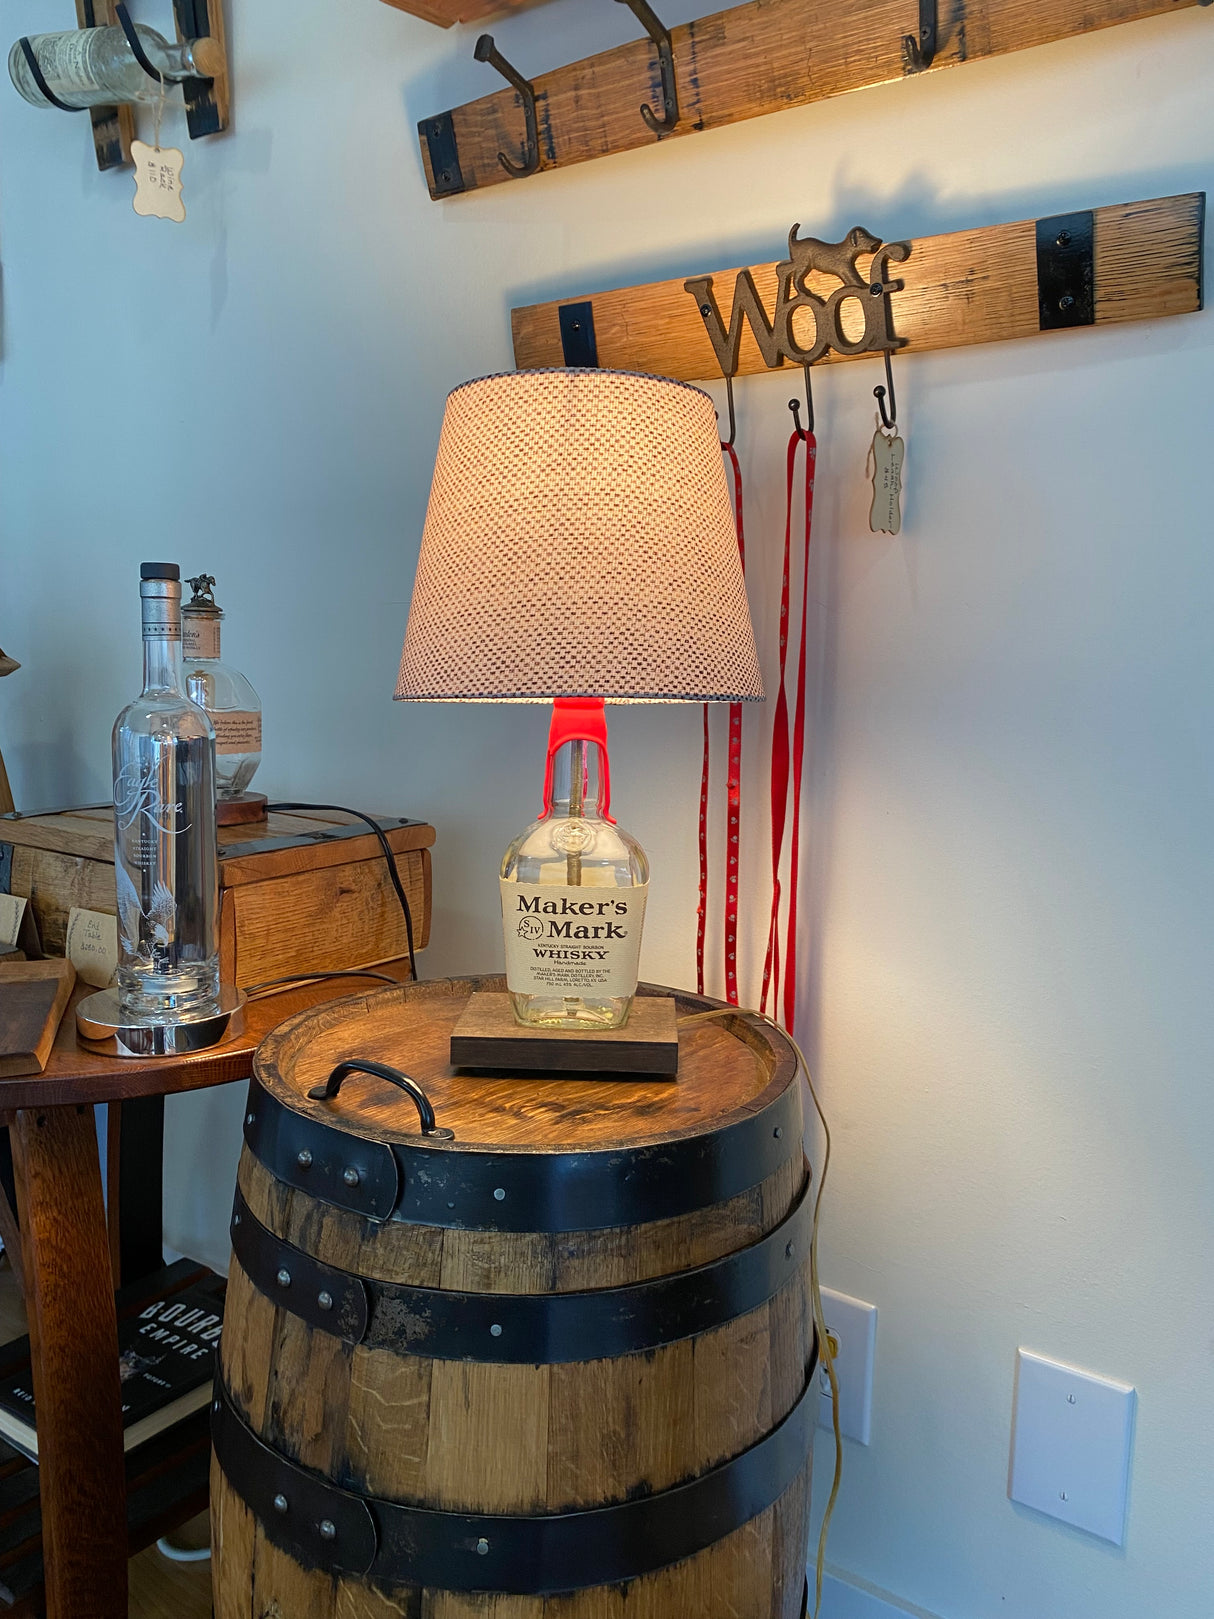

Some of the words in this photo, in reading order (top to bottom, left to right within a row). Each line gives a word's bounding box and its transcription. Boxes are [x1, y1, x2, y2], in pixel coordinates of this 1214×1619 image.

[683, 243, 911, 375] Woof
[113, 755, 170, 816] Eagle
[118, 789, 193, 834] Rare
[516, 894, 628, 916] Maker's
[546, 920, 627, 940] Mark
[532, 948, 610, 960] WHISKY
[138, 1301, 224, 1348] BOURB
[138, 1322, 209, 1360] EMPIRE
